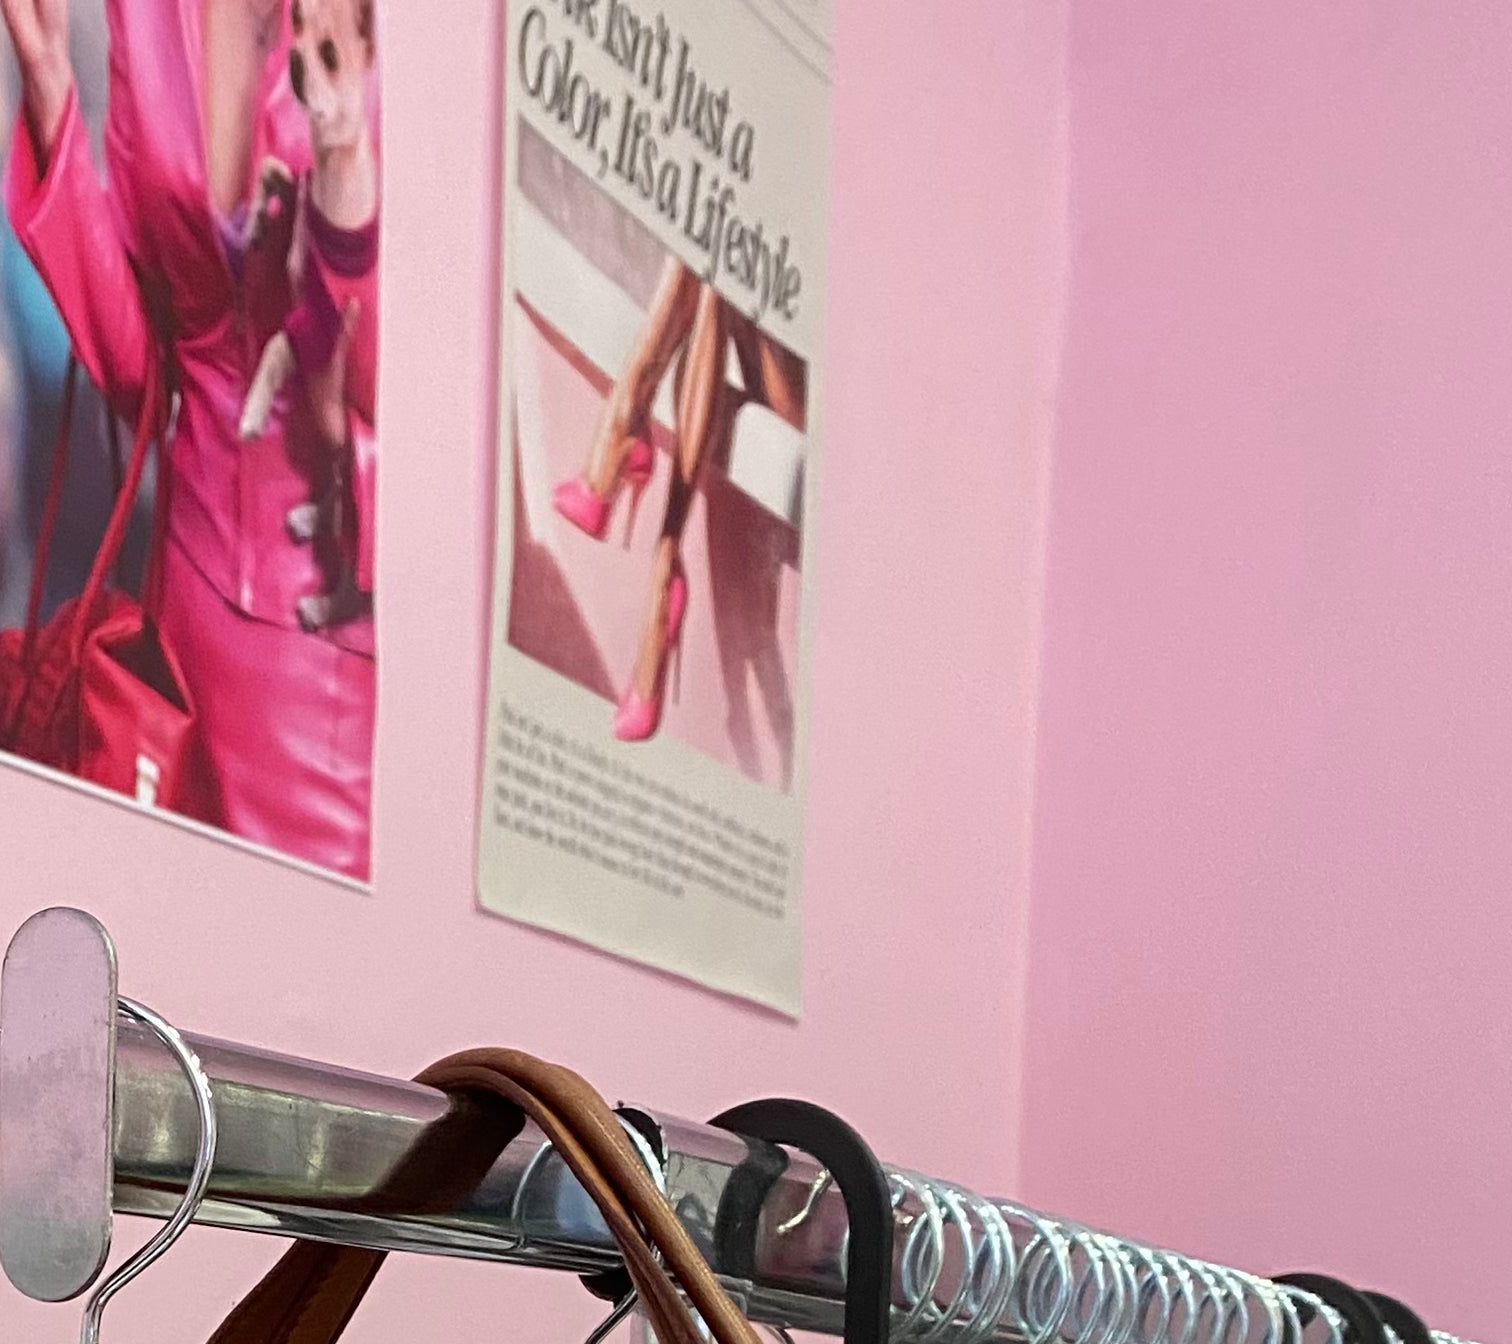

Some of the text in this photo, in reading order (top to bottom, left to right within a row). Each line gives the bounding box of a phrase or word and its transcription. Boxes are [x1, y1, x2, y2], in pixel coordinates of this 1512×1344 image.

[518, 5, 610, 178] Color,
[655, 159, 681, 223] a
[683, 160, 801, 326] Lifestyle
[660, 36, 730, 157] Just
[729, 120, 755, 183] a
